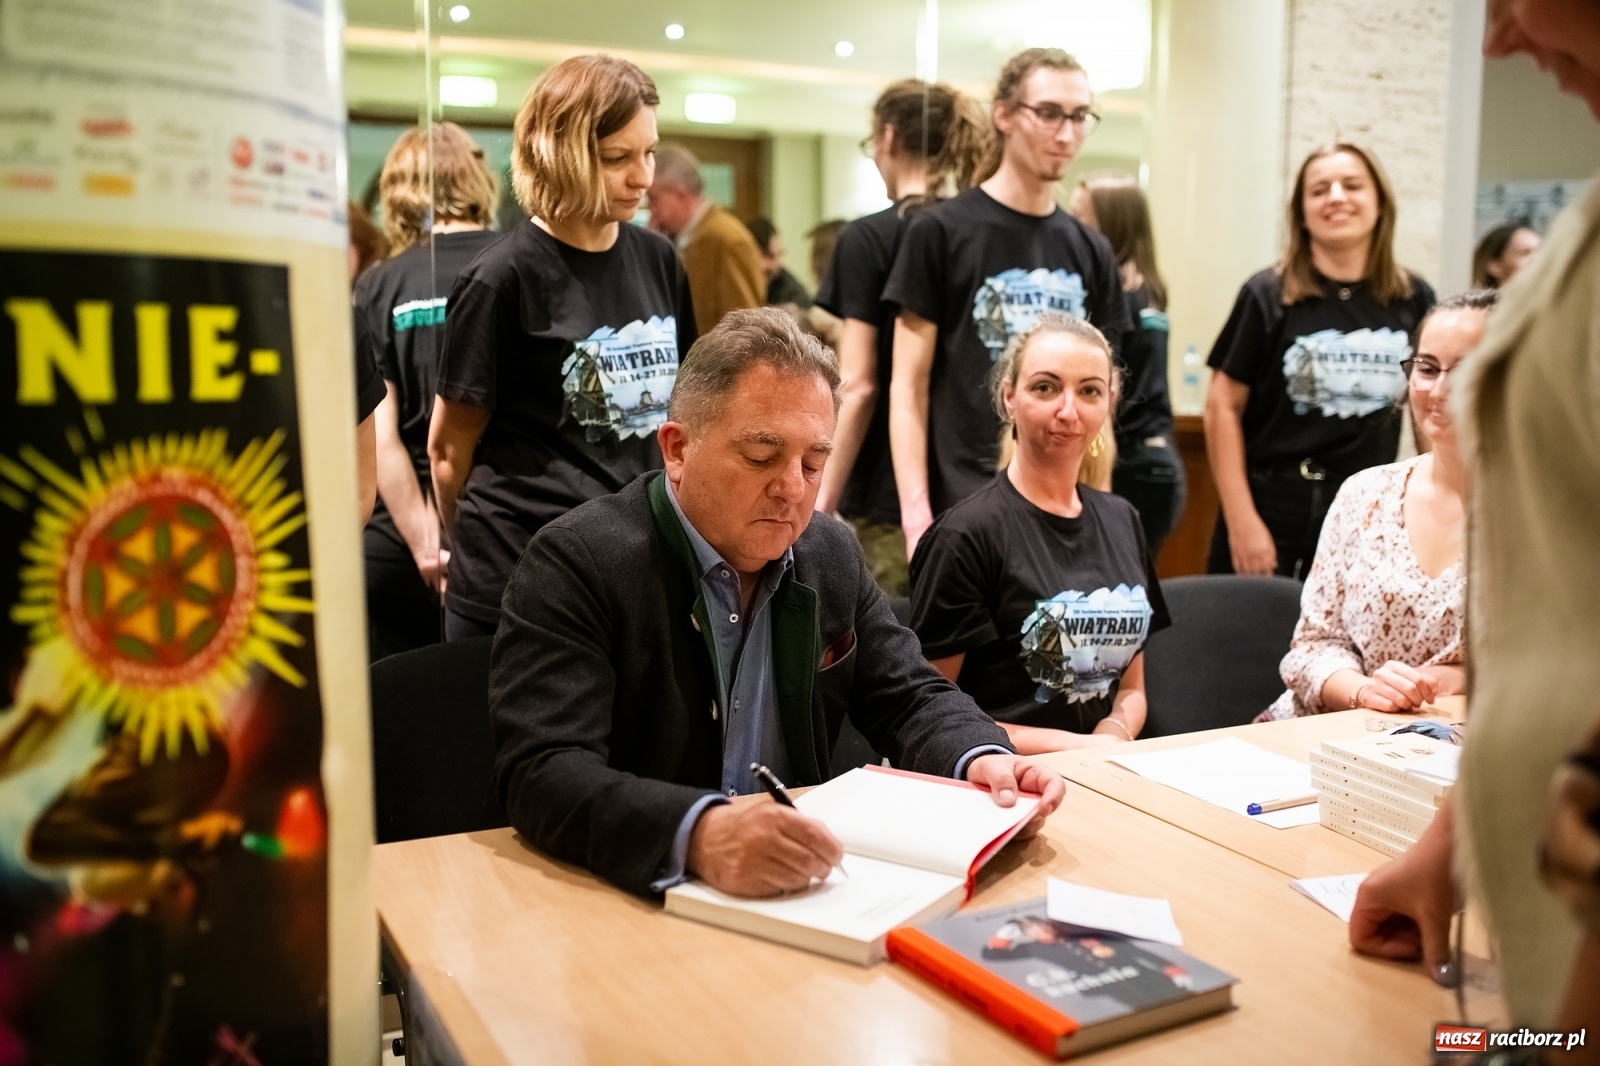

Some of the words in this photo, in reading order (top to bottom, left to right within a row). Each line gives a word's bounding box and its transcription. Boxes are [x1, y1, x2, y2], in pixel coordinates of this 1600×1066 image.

[1005, 291, 1071, 312] WIATAKI
[4, 297, 280, 405] NIE-
[1063, 617, 1143, 636] WIATRAKI
